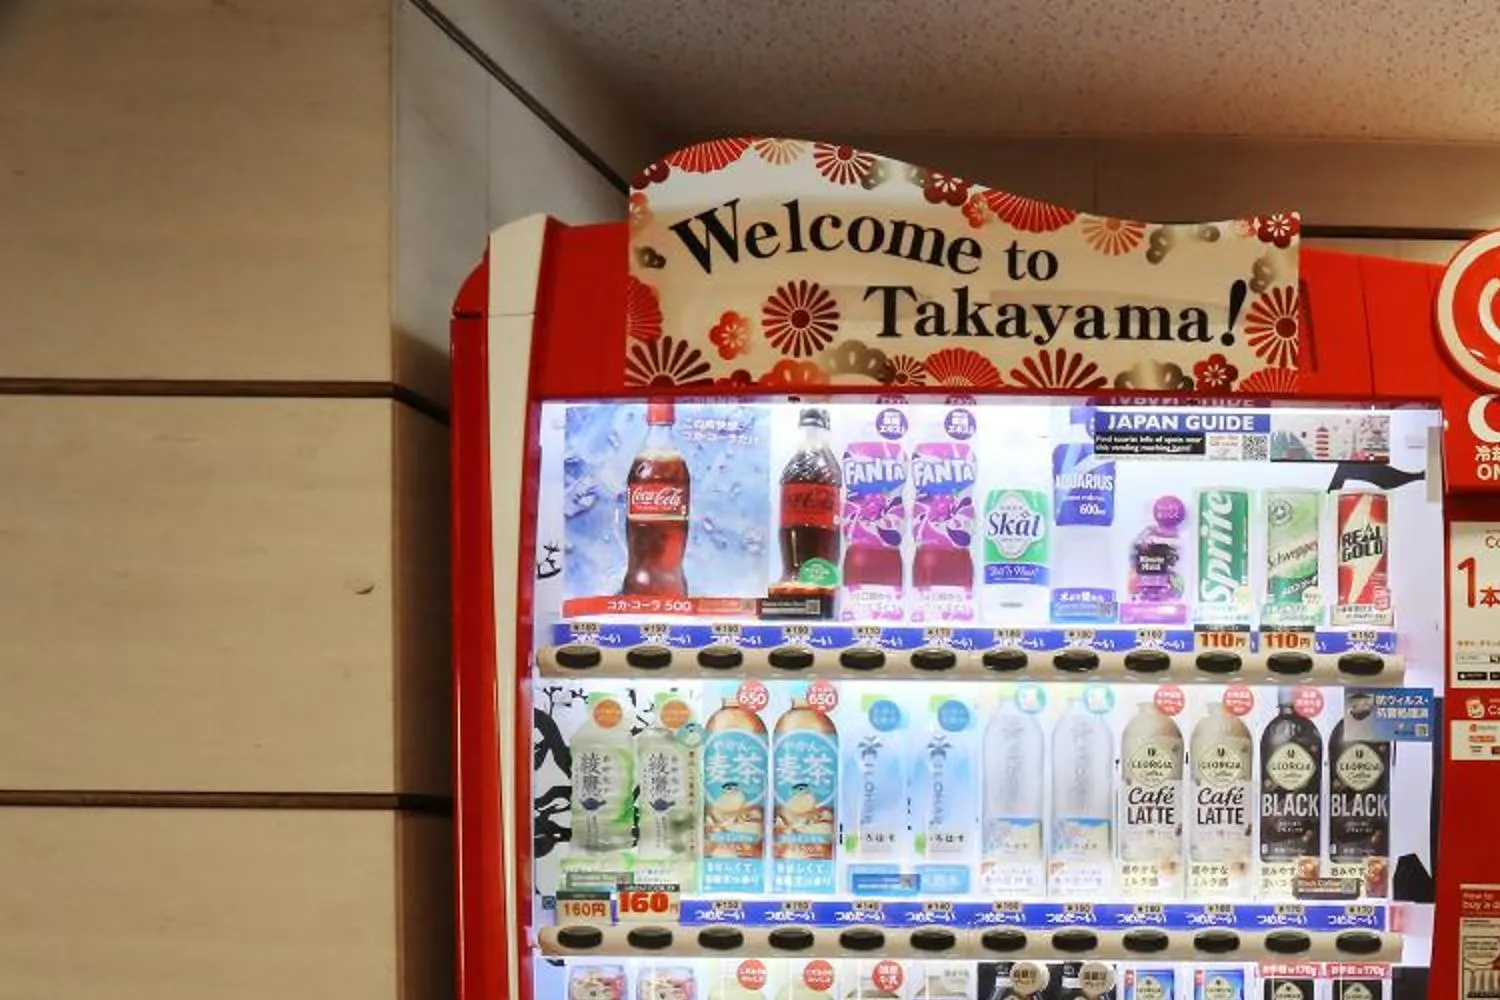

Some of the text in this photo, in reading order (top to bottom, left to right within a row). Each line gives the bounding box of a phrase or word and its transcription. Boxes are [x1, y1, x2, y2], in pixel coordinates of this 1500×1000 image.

[668, 197, 1059, 282] Welcome to
[863, 279, 1247, 346] Takayama!
[1107, 415, 1254, 430] JAPAN GUIDE
[845, 458, 906, 486] FANTA
[914, 458, 974, 487] FANTA
[1341, 524, 1383, 547] REAL
[1201, 491, 1240, 604] Sprite
[1341, 543, 1383, 563] GOLD
[665, 601, 692, 612] 500
[1200, 632, 1245, 648] 110円
[1264, 633, 1310, 648] 110円
[706, 755, 767, 784] 麦茶
[1128, 786, 1175, 806] Café
[1197, 786, 1244, 806] Café
[1262, 793, 1319, 817] BLACK
[1331, 793, 1388, 817] BLACK
[1127, 806, 1175, 825] LATTE
[1197, 807, 1244, 825] LATTE
[563, 903, 606, 917] 160円
